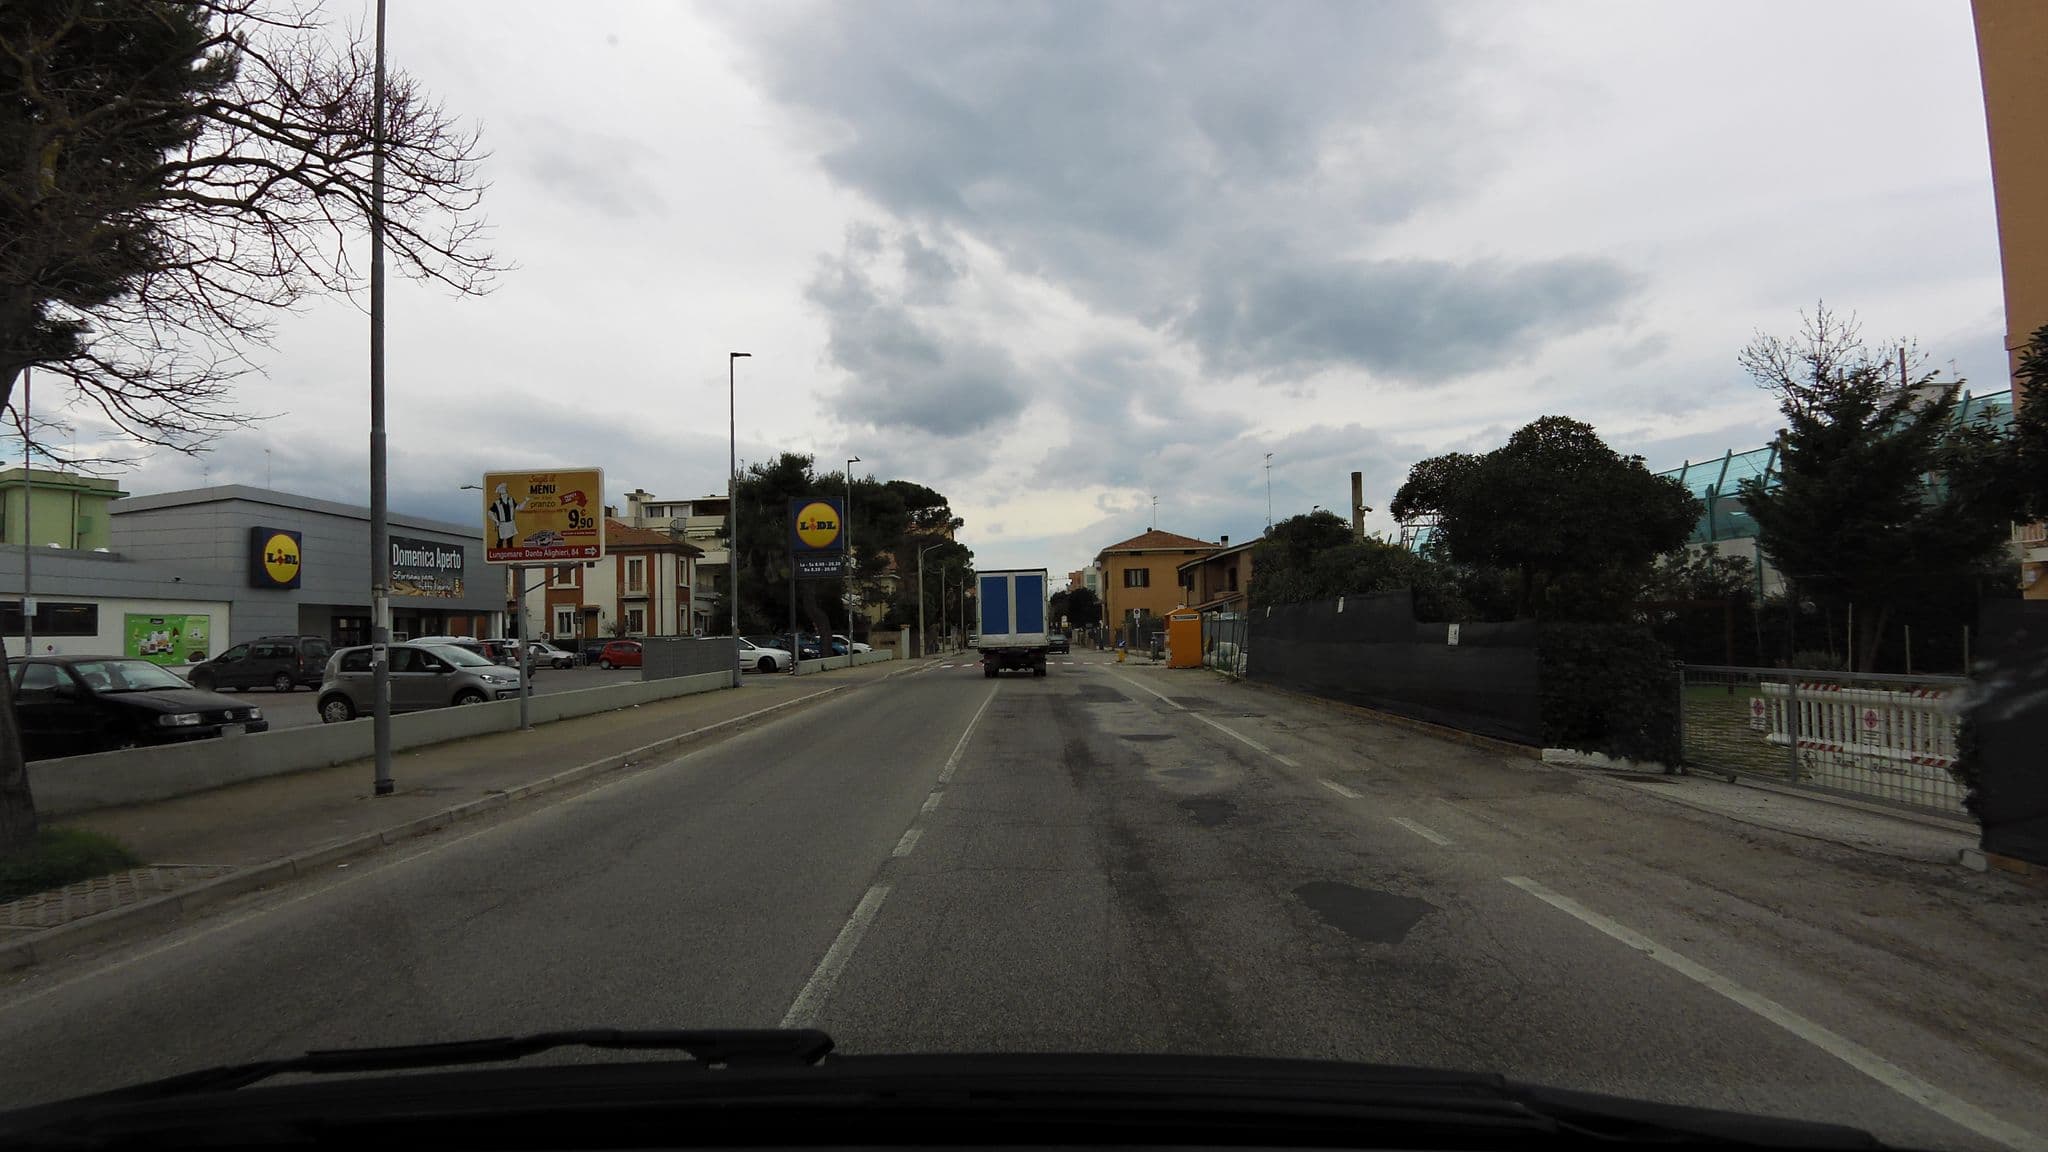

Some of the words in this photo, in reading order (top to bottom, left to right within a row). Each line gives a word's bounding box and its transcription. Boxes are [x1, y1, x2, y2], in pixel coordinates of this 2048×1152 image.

[530, 485, 555, 495] MENU
[530, 502, 556, 510] pranzo
[800, 519, 836, 531] LIDL
[267, 548, 298, 566] LIDL
[393, 544, 435, 567] Domenica
[436, 547, 461, 572] Aperto
[489, 551, 522, 560] Lungomare
[525, 550, 543, 558] Dante
